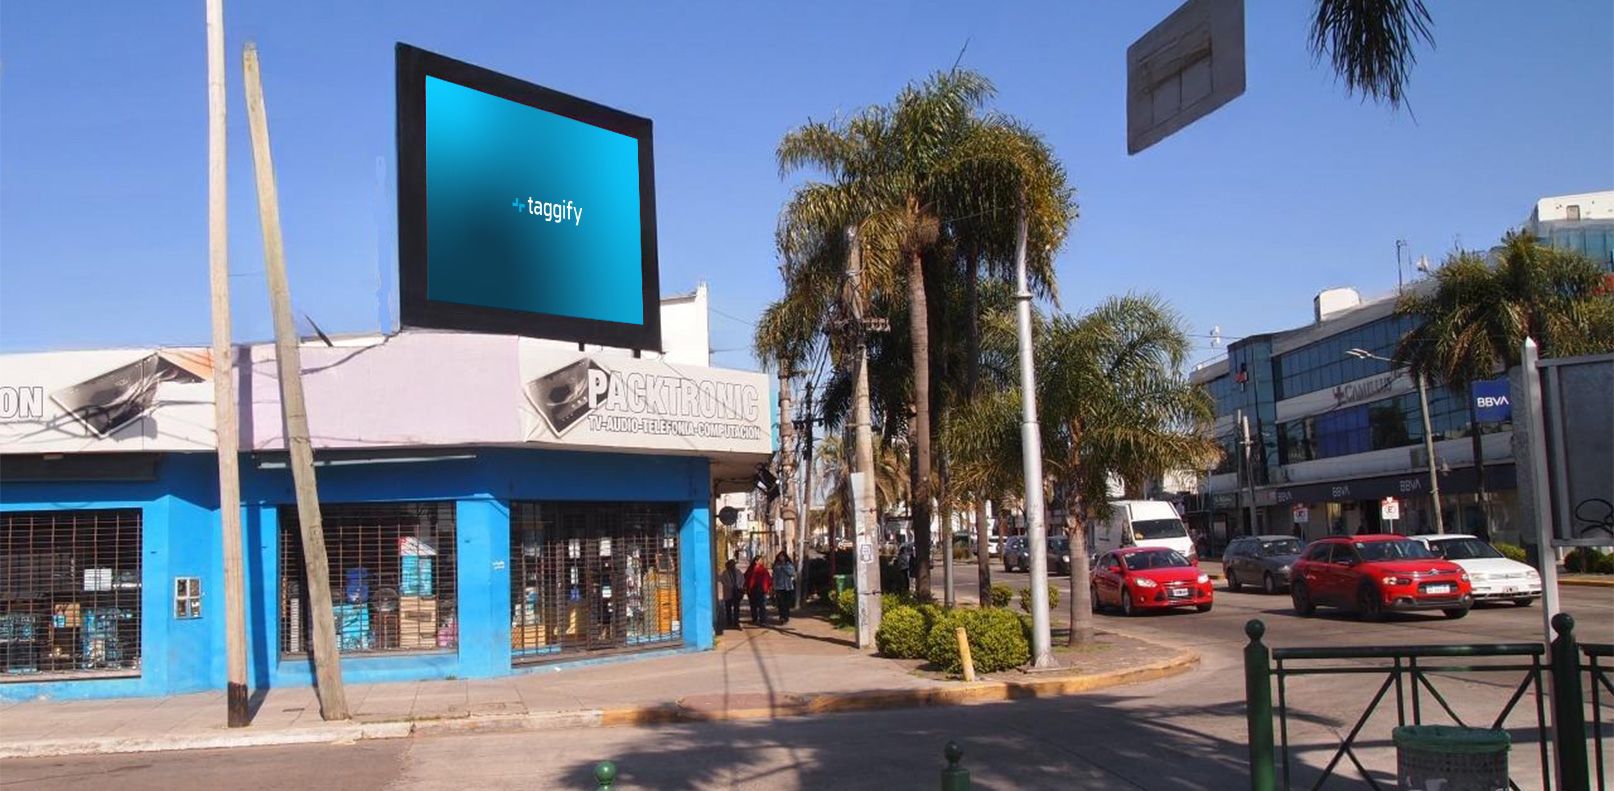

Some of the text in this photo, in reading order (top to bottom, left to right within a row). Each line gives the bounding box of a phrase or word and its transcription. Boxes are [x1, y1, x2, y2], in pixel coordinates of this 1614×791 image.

[527, 196, 583, 226] taggify
[0, 386, 43, 419] ON
[587, 368, 759, 422] PACKTRONIC
[1477, 395, 1509, 408] BBVA
[1332, 485, 1350, 497] BBVA
[1399, 478, 1422, 492] BBVA
